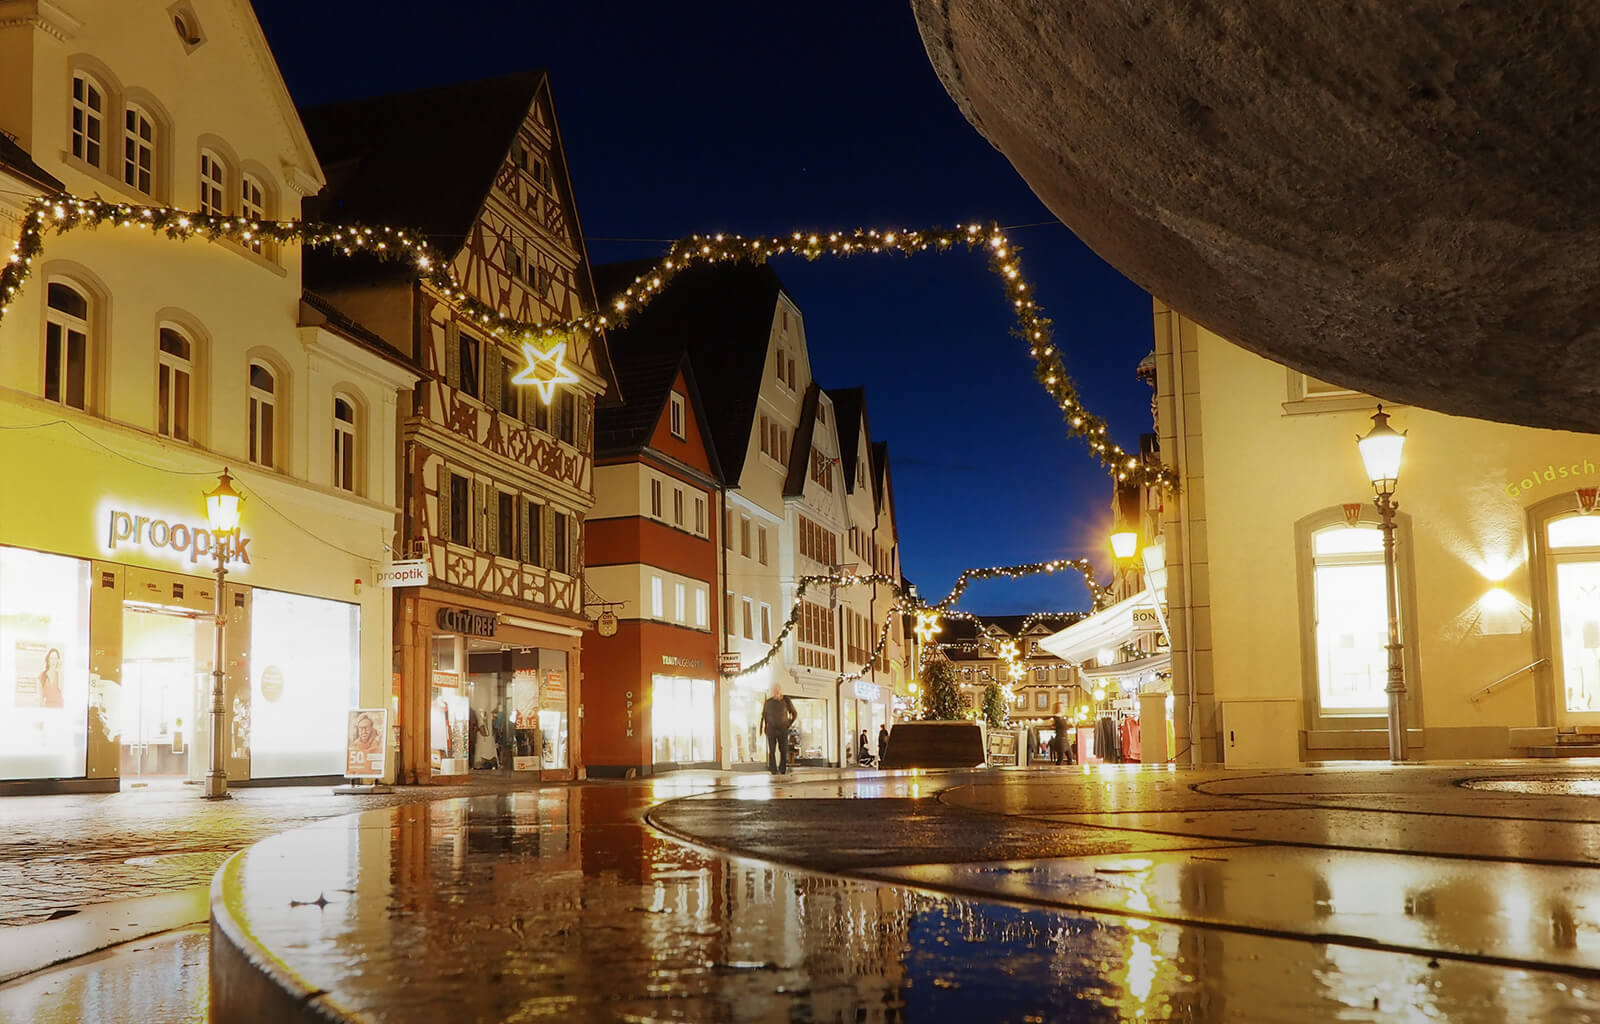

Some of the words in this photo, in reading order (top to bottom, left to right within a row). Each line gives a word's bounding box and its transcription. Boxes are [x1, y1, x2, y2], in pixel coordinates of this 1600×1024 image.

[1504, 459, 1600, 497] Goldsch
[376, 568, 424, 582] prooptik
[515, 670, 537, 678] SALE
[625, 691, 634, 737] OPTIK
[515, 719, 537, 729] SALE
